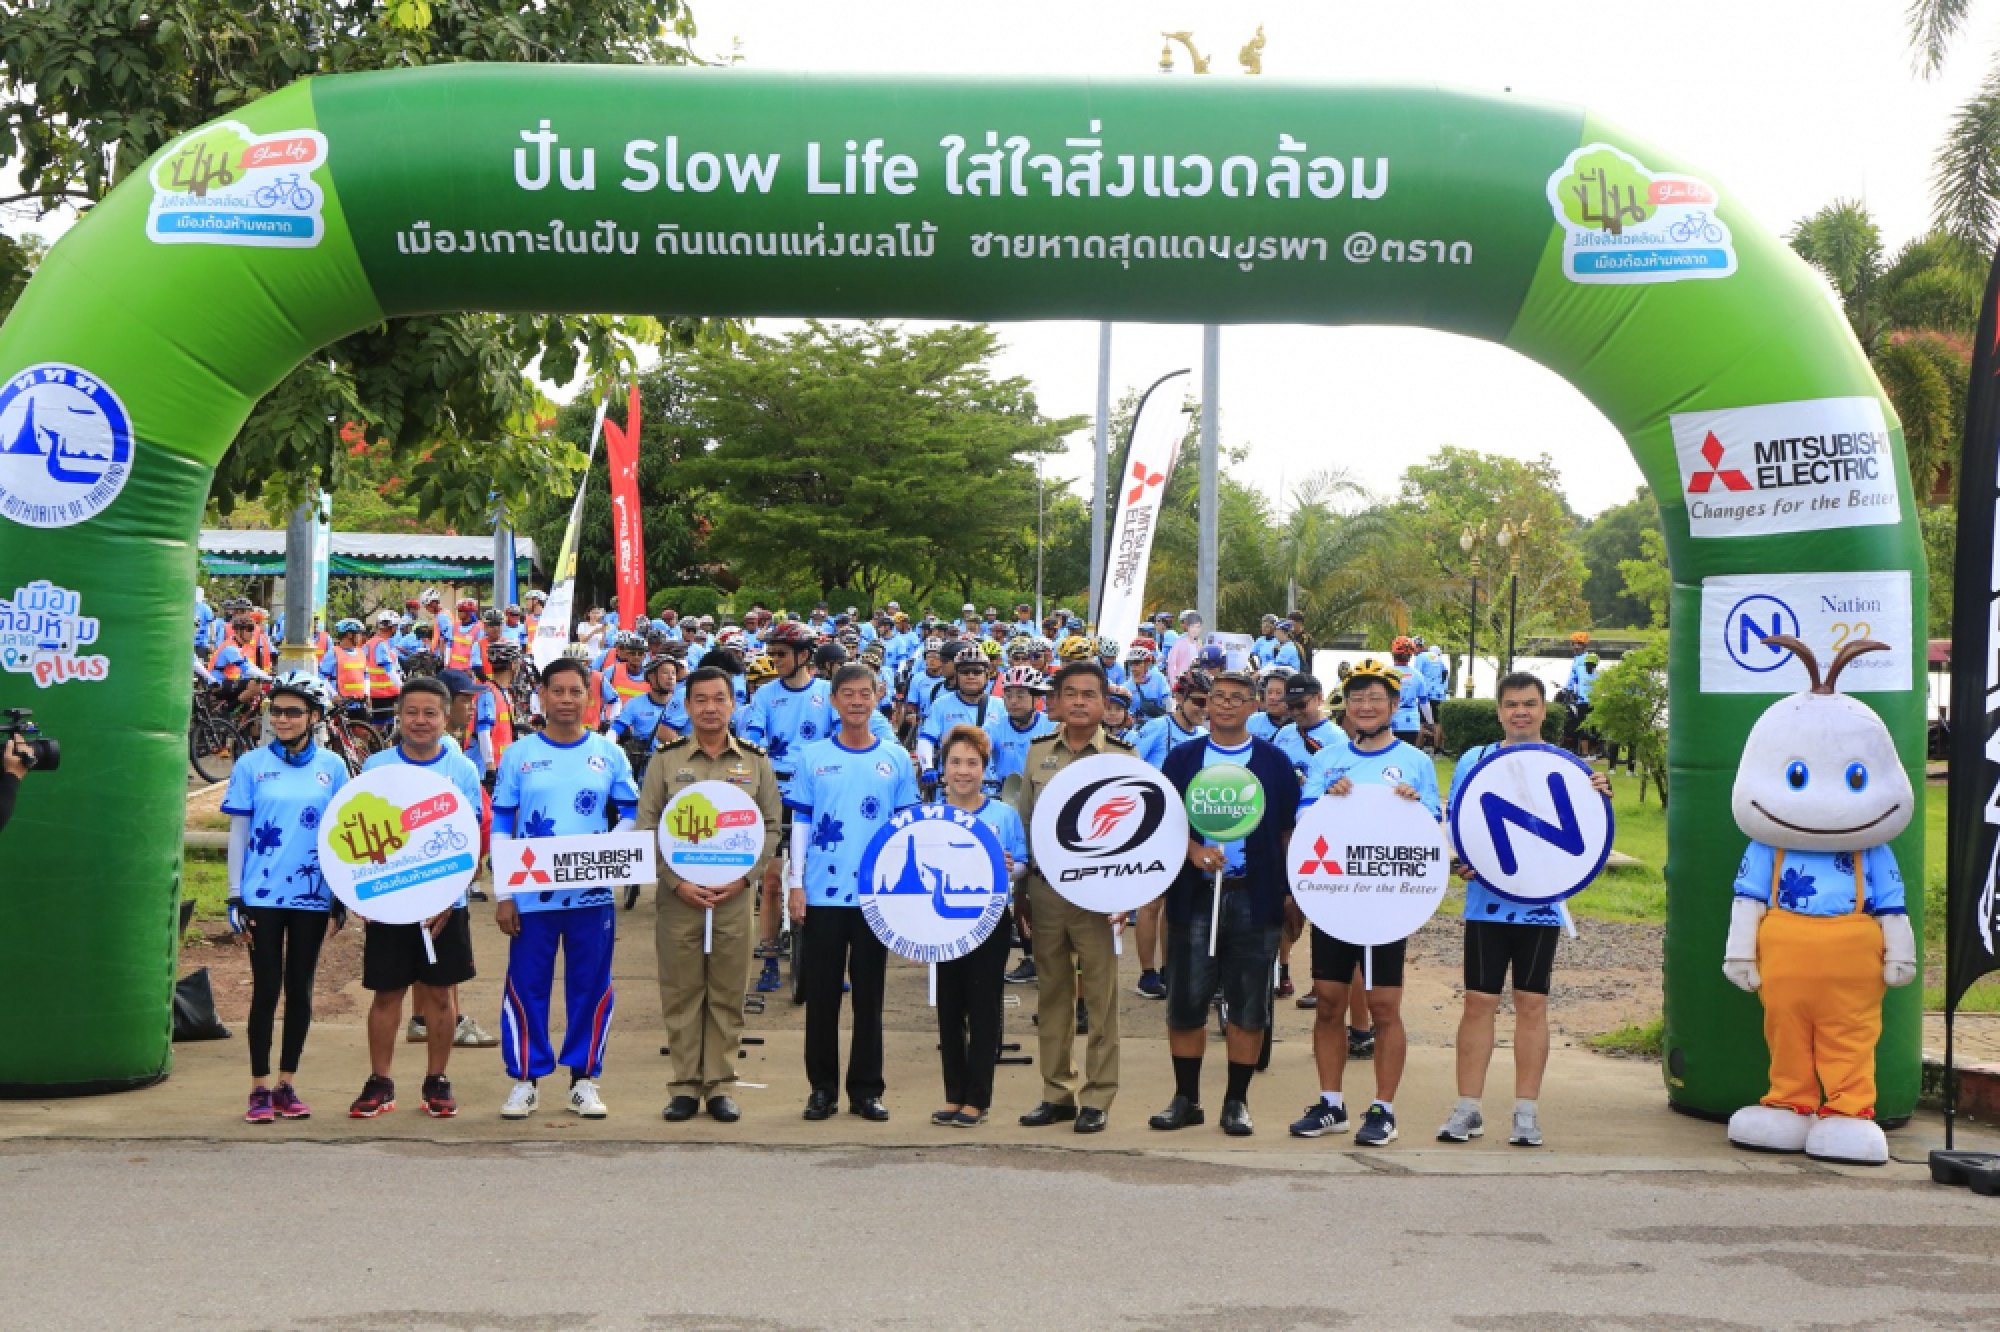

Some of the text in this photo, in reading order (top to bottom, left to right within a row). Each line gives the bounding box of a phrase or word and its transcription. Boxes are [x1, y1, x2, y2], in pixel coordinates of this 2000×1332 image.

[513, 118, 1390, 200] ปั่น Slow Life ใส่ใจสิ่งแวดล้อม
[655, 220, 938, 257] ดินแดนแห่งผลไม้
[1343, 231, 1474, 265] @ตราด
[1754, 431, 1889, 465] MITSUBISHI
[1757, 456, 1879, 490] ELECTRIC
[1691, 489, 1895, 521] Changes for the Better
[1820, 595, 1881, 613] Nation
[35, 655, 104, 684] plus
[1191, 786, 1237, 803] eco
[1191, 801, 1259, 819] Changes
[1479, 771, 1585, 876] N
[553, 847, 643, 867] MITSUBISHI
[1345, 845, 1441, 862] MITSUBISHI
[555, 863, 632, 883] ELECTRIC
[1059, 859, 1167, 883] OPTIMA
[1345, 860, 1427, 878] ELECTRIC
[1295, 879, 1438, 895] Changes for the Better
